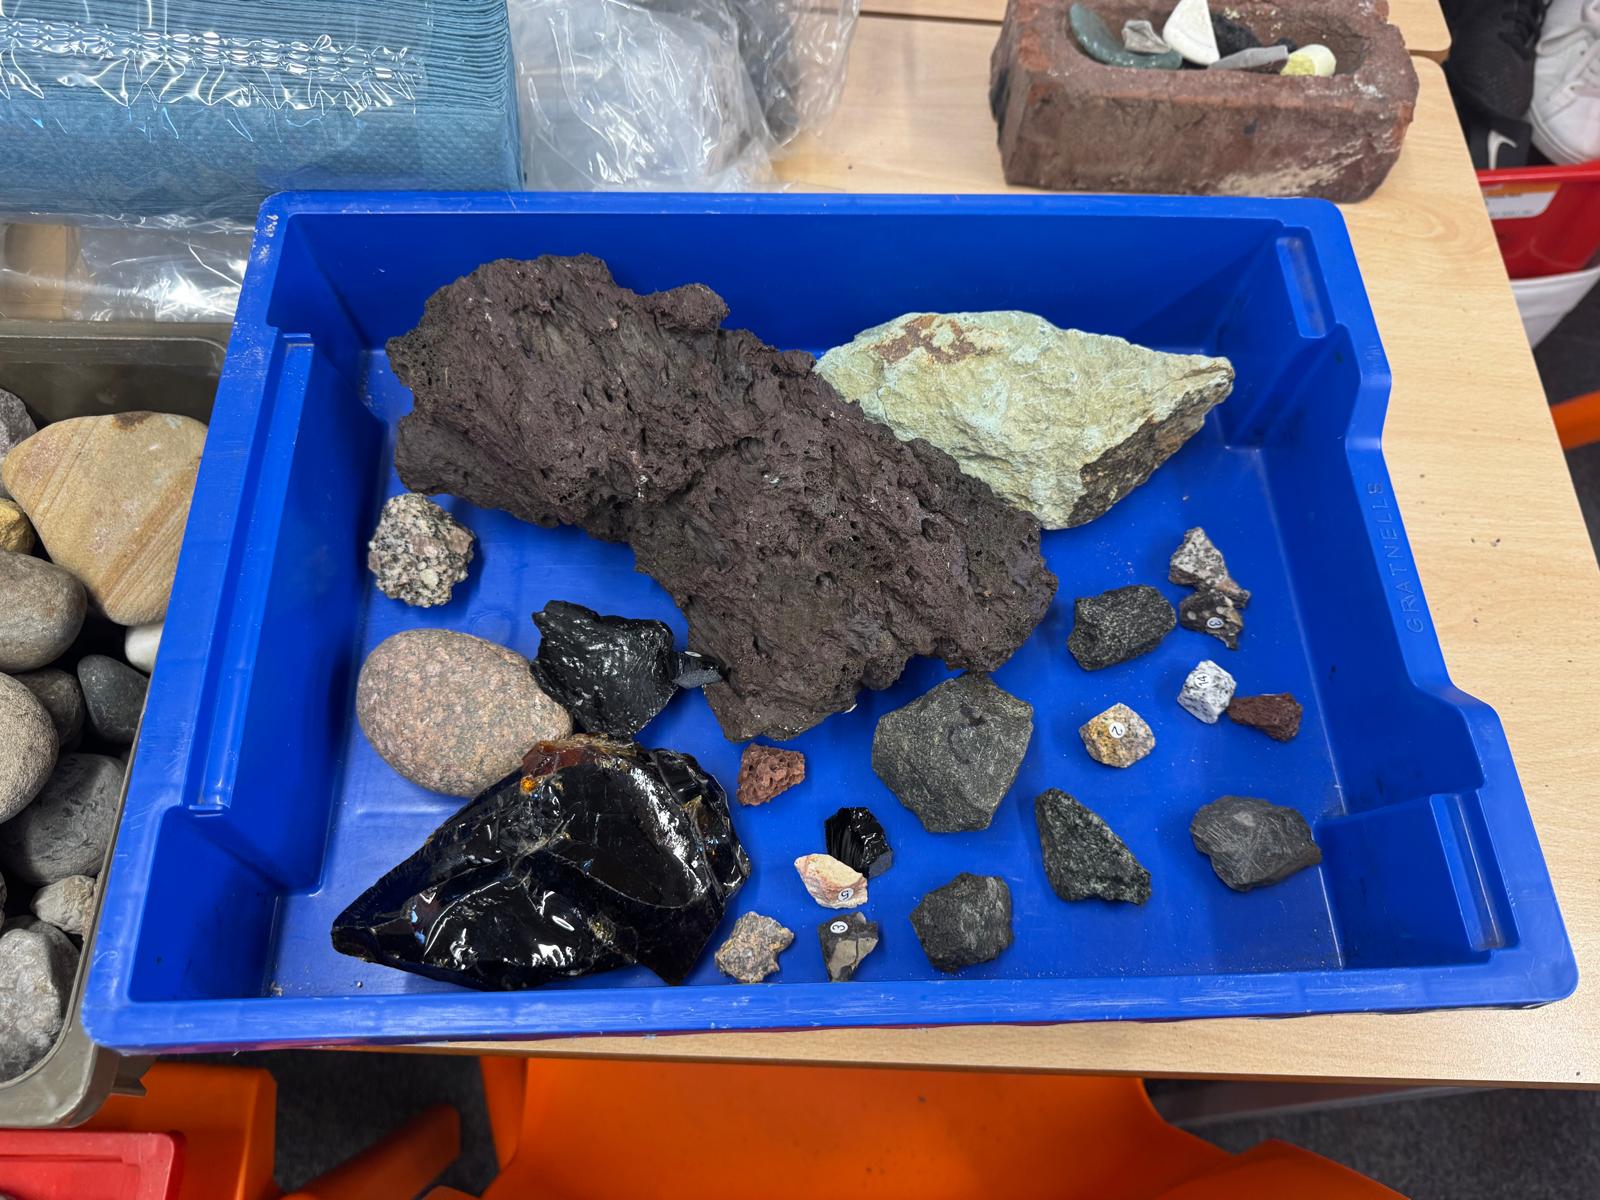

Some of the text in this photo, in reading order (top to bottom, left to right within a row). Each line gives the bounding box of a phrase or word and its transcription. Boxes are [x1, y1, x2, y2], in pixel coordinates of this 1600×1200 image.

[1367, 482, 1425, 634] GRATNELLS
[1196, 675, 1209, 687] 14
[841, 890, 850, 901] 5
